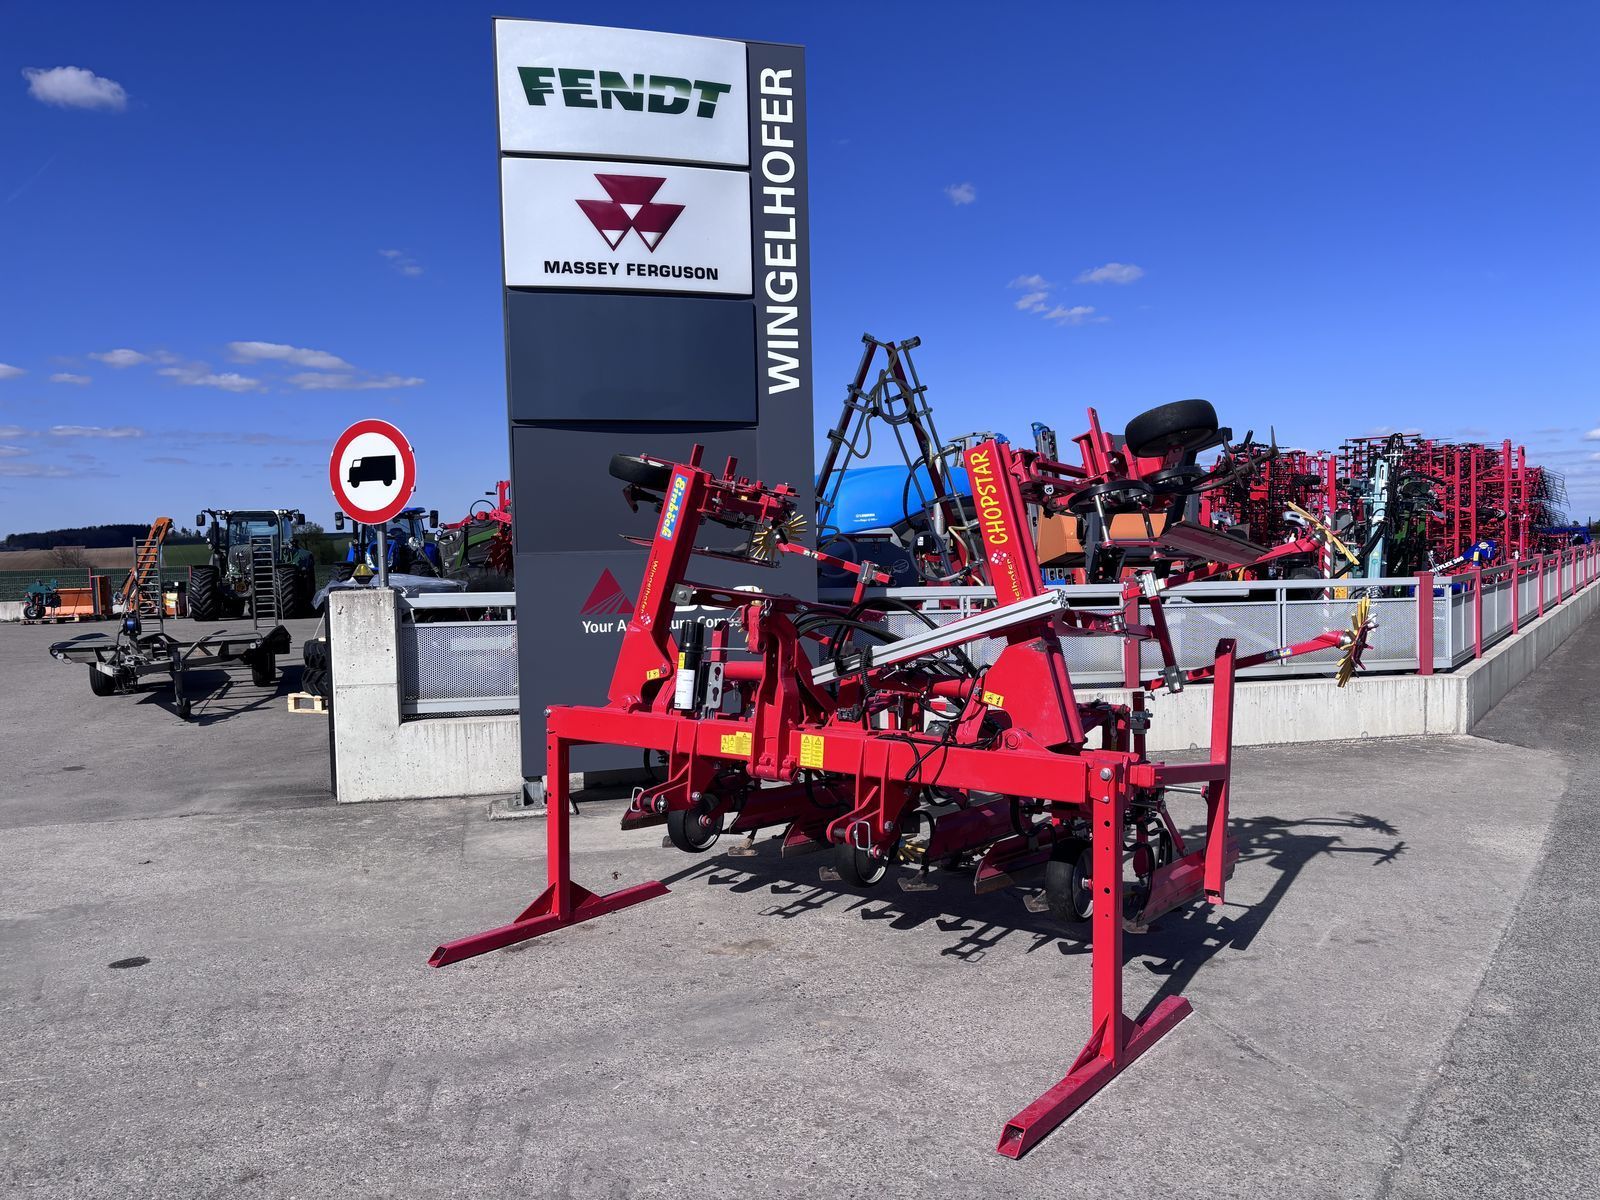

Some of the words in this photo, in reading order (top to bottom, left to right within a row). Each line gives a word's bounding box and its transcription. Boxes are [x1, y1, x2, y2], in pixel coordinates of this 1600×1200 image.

[517, 66, 732, 119] FENDT
[760, 67, 800, 395] WINGELHOFER
[544, 260, 620, 275] MASSEY
[626, 263, 719, 280] FERGUSON
[970, 449, 1009, 545] CHOPSTAR
[582, 620, 614, 634] Your
